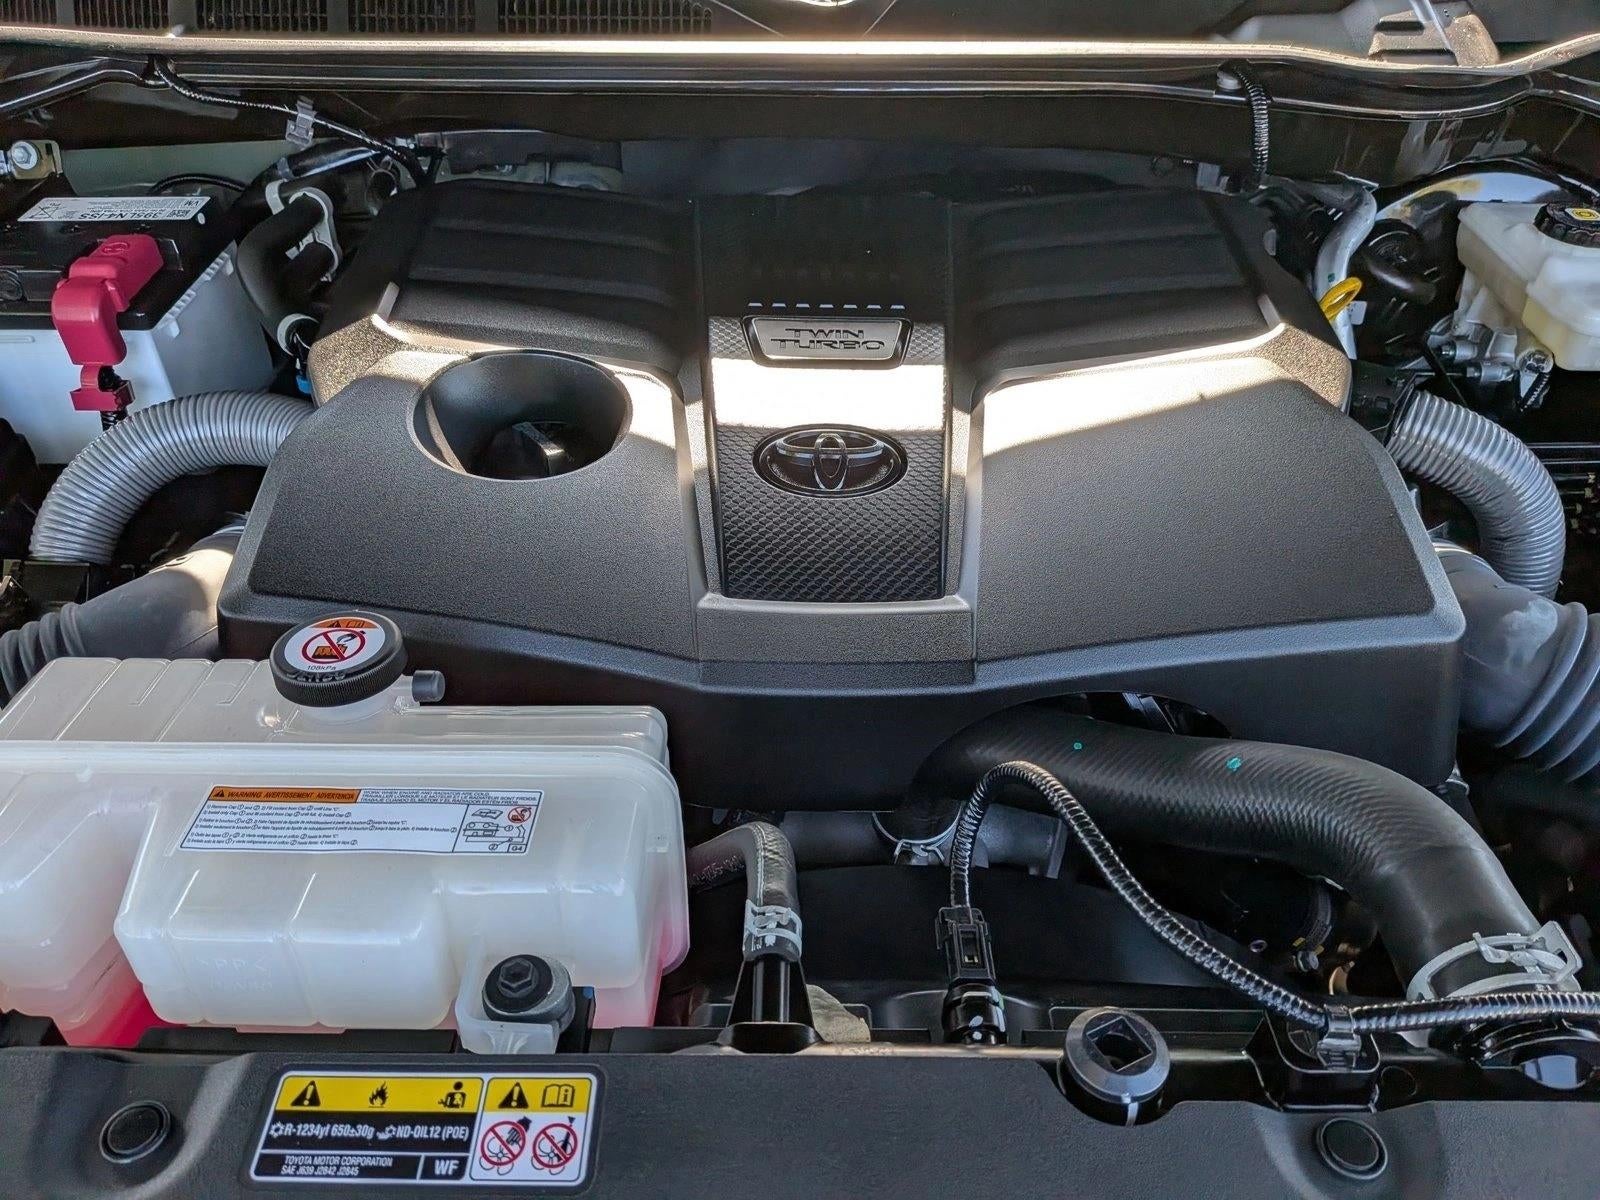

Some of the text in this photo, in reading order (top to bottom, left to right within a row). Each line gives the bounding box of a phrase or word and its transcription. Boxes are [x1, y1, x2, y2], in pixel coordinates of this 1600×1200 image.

[785, 328, 864, 339] TWIN
[770, 338, 885, 350] TURBO
[227, 791, 355, 800] WARNING AVERTISSEMENT ADVERTENCIA
[284, 1123, 330, 1139] R-1234yf
[331, 1124, 375, 1140] 650±30g
[442, 1125, 470, 1142] (POE)
[285, 1155, 393, 1167] TOYOTA MOTOR CORPORATION
[434, 1159, 459, 1175] WF
[281, 1165, 296, 1175] SAE
[296, 1166, 314, 1175] J639
